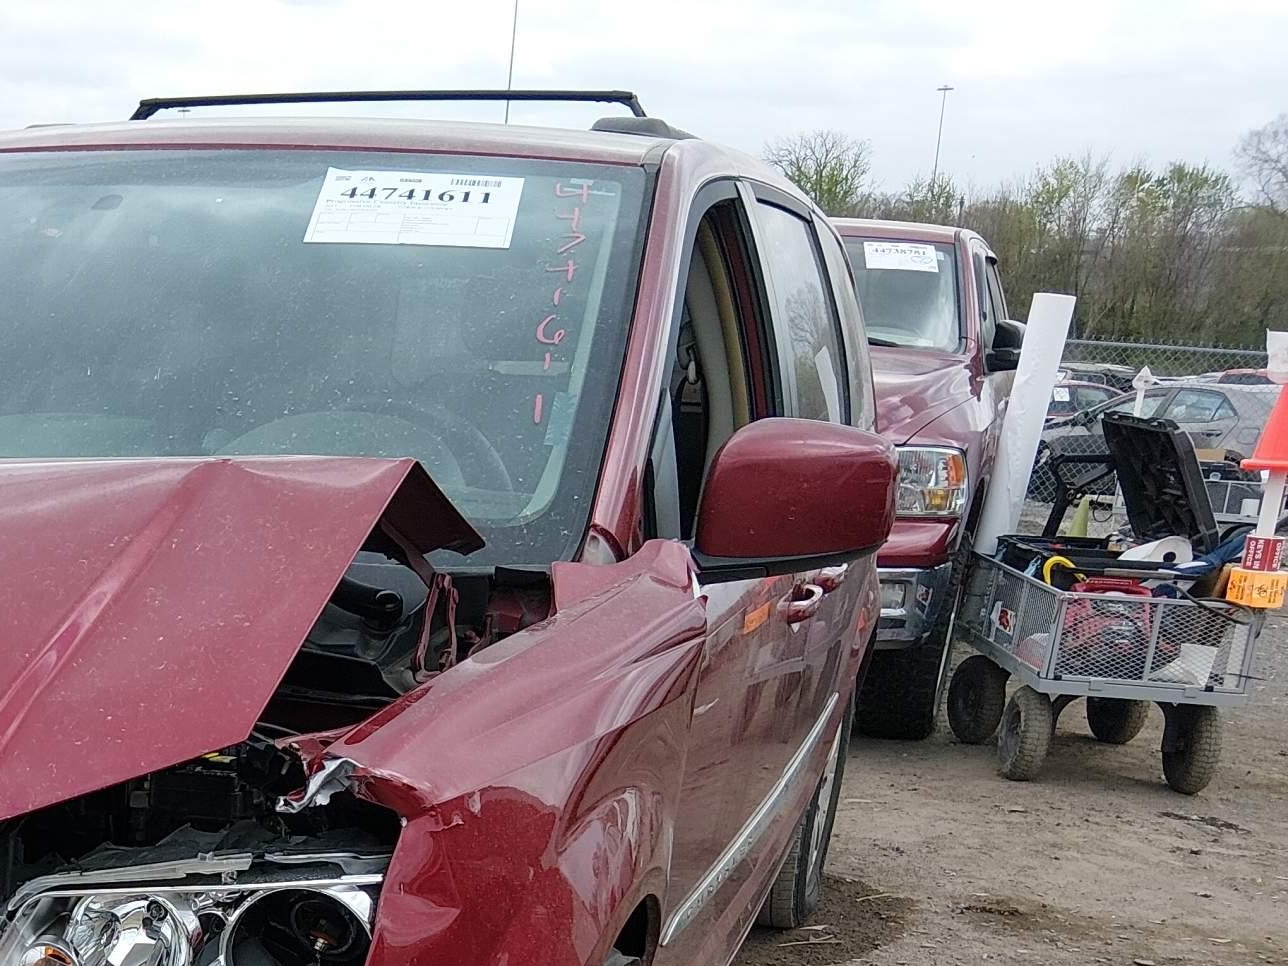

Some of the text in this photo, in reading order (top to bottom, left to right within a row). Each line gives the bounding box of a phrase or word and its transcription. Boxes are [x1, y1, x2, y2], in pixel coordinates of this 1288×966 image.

[340, 186, 492, 204] 44741611
[1245, 540, 1257, 567] OFFICE
[1252, 539, 1265, 569] KEYS IN
